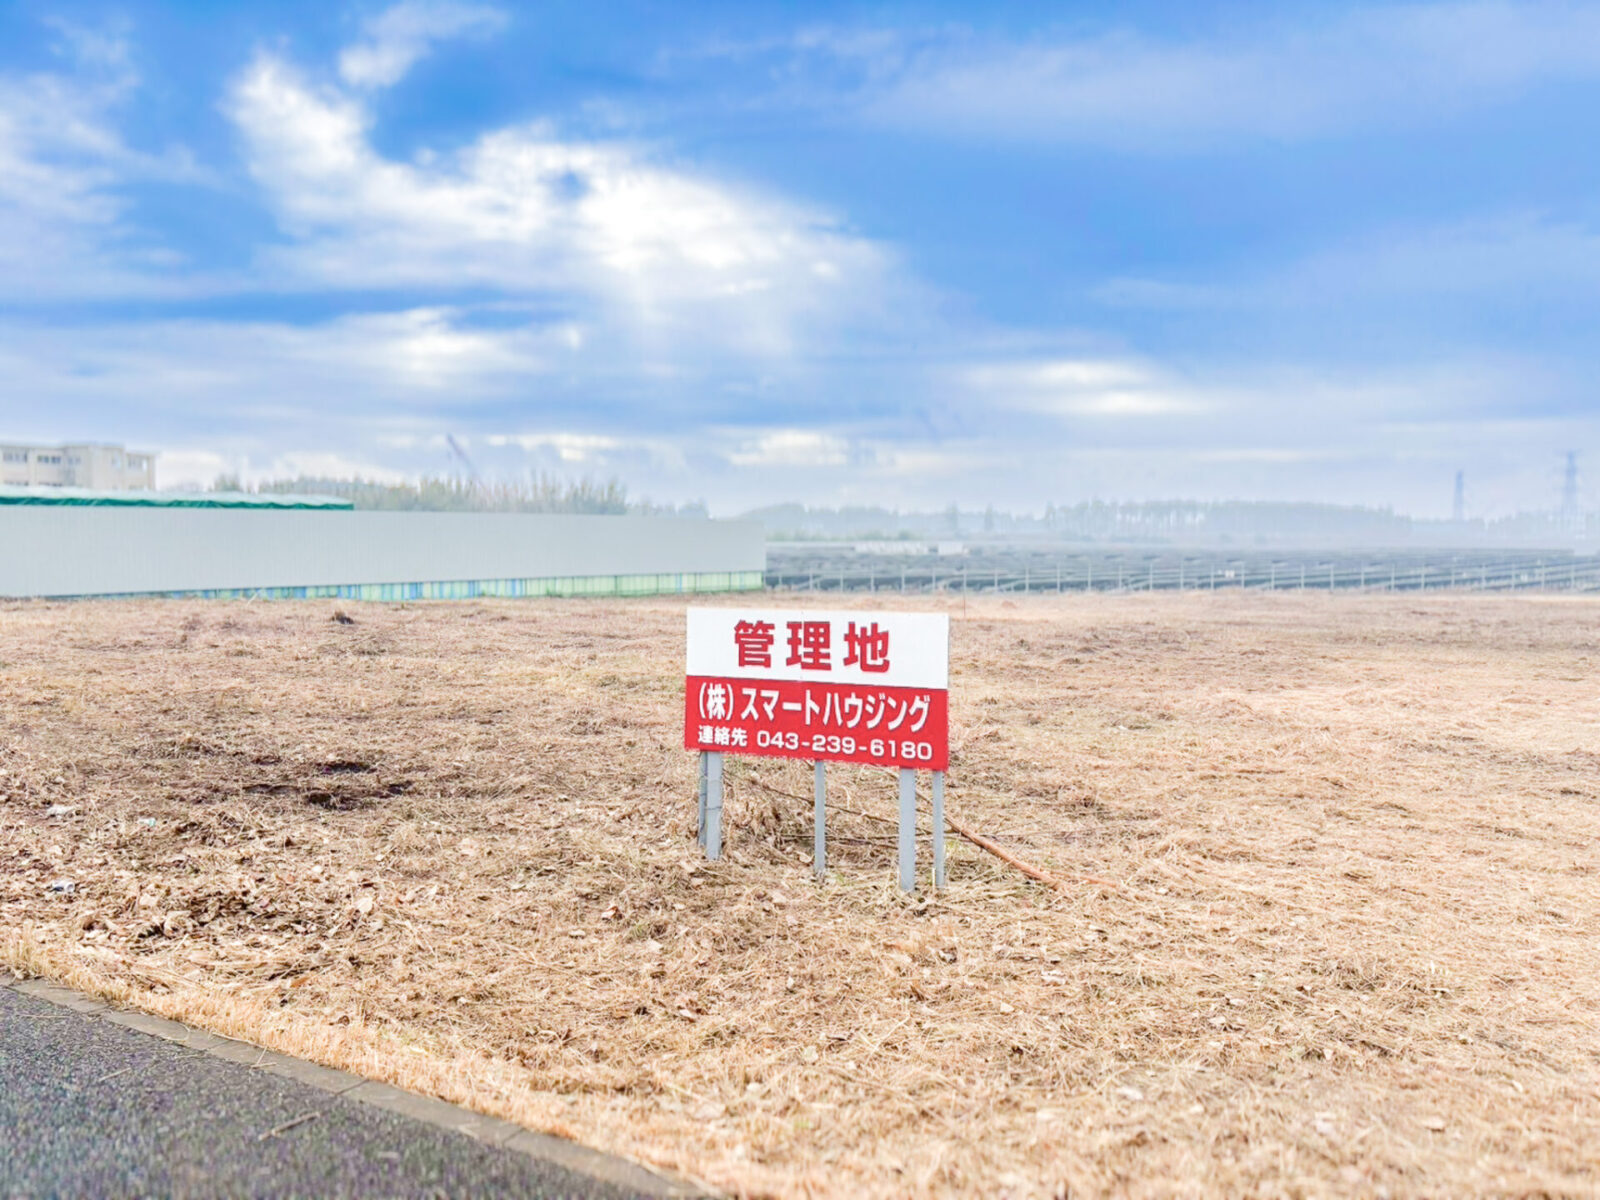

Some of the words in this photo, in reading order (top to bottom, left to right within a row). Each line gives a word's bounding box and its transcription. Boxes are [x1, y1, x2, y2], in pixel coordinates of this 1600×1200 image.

[734, 619, 890, 673] 管理地
[697, 724, 748, 747] 連絡先
[757, 730, 933, 760] 043-239-6180
